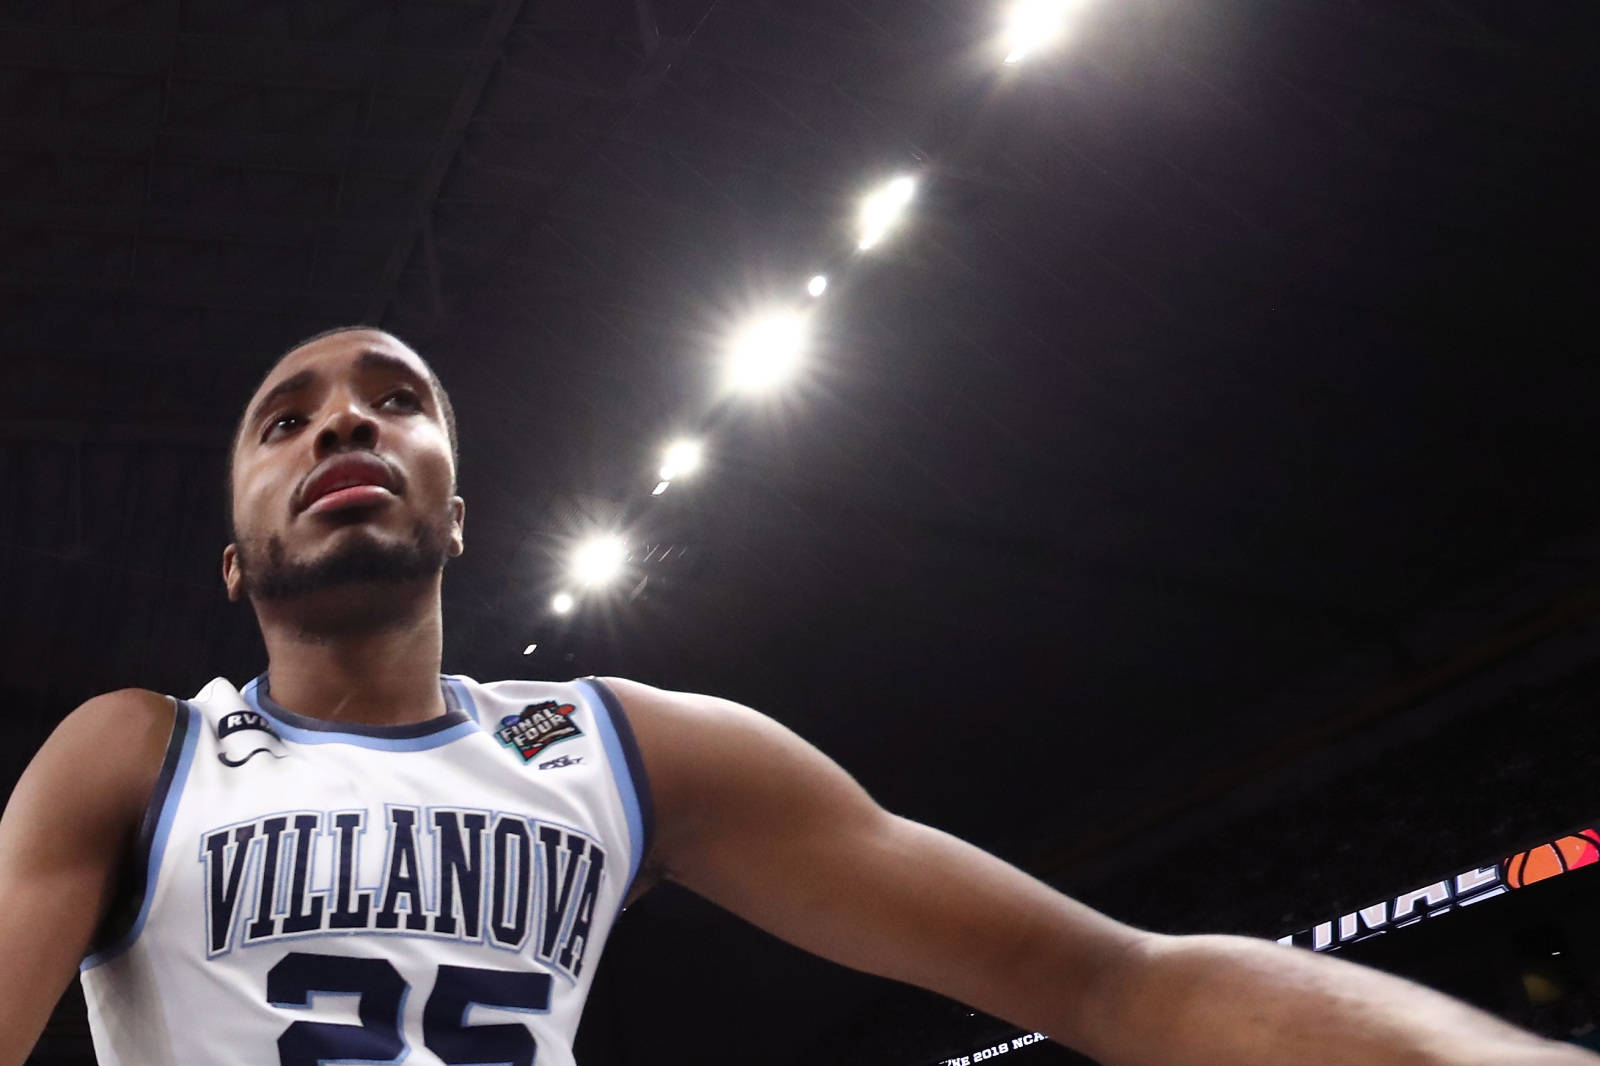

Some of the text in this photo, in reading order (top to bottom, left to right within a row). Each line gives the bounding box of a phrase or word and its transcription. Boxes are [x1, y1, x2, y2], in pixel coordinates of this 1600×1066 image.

[500, 708, 555, 742] FINAL
[513, 714, 567, 747] FOUR
[200, 803, 607, 985] VILLANOVA
[973, 1043, 1009, 1062] 2018
[1012, 1032, 1048, 1049] NCA
